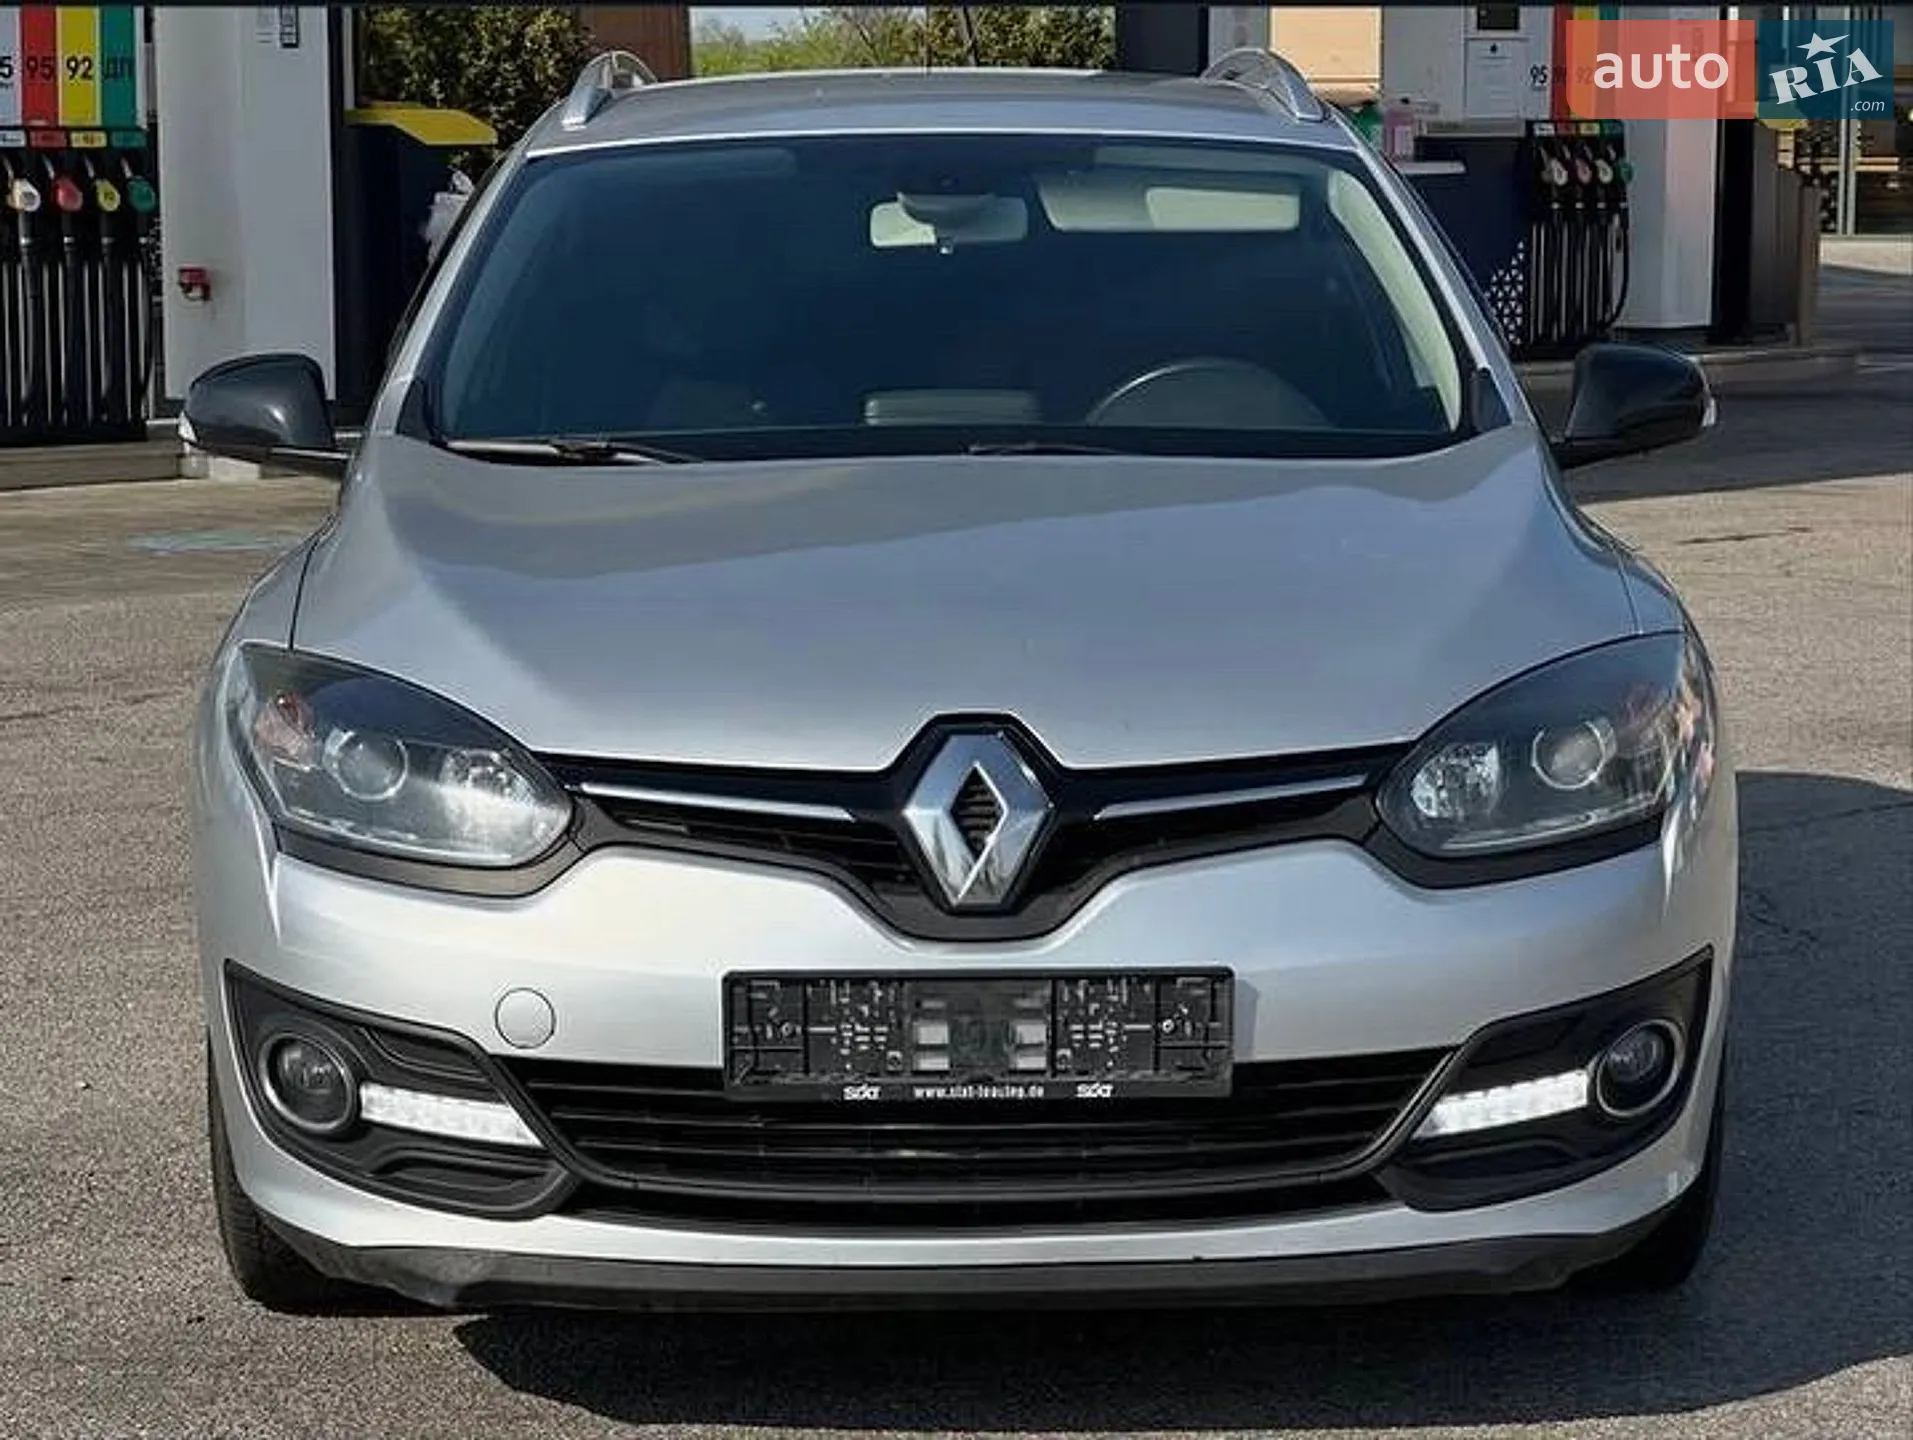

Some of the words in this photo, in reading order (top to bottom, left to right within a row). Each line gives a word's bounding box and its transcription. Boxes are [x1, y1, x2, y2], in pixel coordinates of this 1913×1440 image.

[0, 56, 14, 79] 5
[26, 56, 54, 81] 95
[66, 55, 93, 81] 92
[1530, 64, 1548, 84] 95
